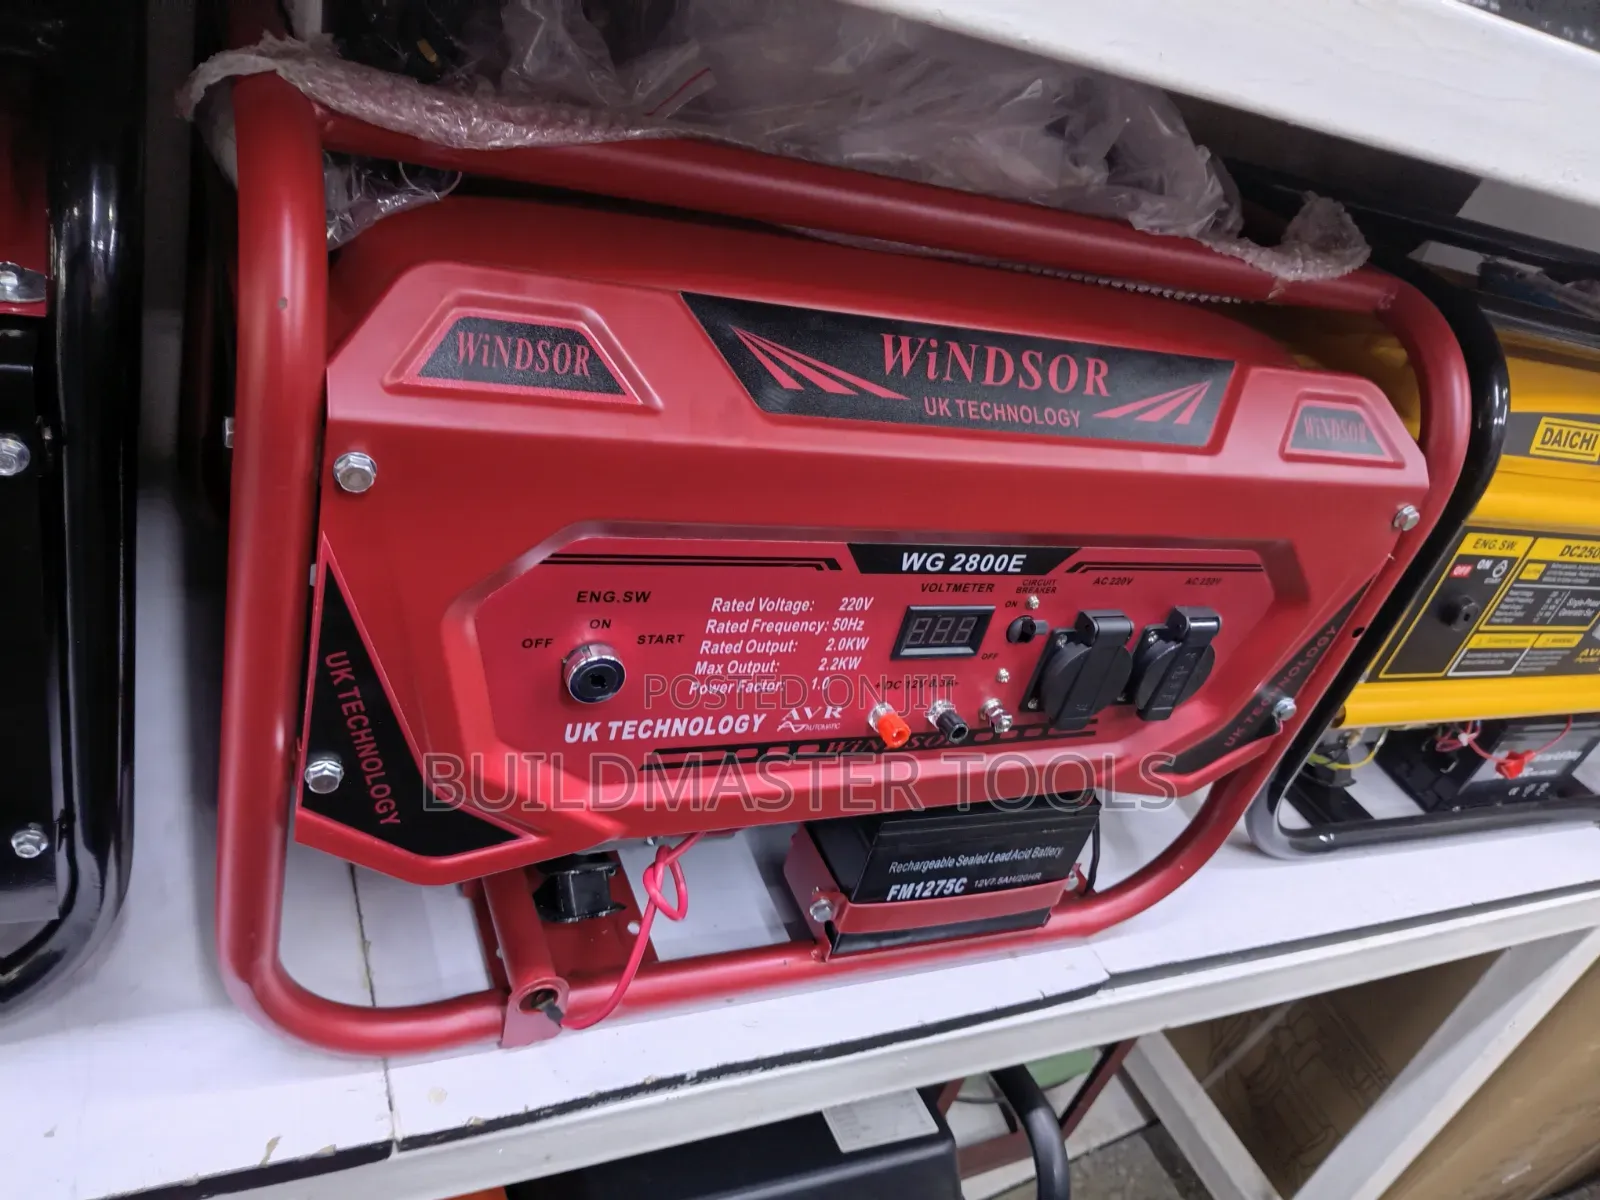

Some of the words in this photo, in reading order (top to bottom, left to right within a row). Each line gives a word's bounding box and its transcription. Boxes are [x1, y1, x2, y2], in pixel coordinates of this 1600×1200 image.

[457, 331, 592, 379] WiNDSOR
[880, 333, 1111, 397] WiNDSOR
[923, 396, 951, 417] UK
[955, 399, 1080, 429] TECHNOLOGY
[1540, 427, 1600, 452] DAICHI
[902, 552, 946, 572] WG
[949, 554, 1027, 573] 2800E
[1477, 559, 1494, 570] ON
[920, 583, 995, 593] VOLTMETER
[1015, 586, 1057, 595] BREAKER
[1022, 579, 1057, 587] CIRCUIT
[1092, 577, 1109, 586] AC
[1109, 577, 1135, 586] 220V
[1184, 578, 1200, 586] AC
[576, 590, 652, 604] ENG.SW
[711, 597, 756, 613] Rated
[757, 597, 815, 615] Voltage:
[838, 597, 875, 612] 220V
[1004, 601, 1018, 609] ON
[589, 619, 612, 630] ON
[705, 618, 749, 635] Rated
[750, 618, 830, 636] Frequency:
[831, 617, 866, 632] 50Hz
[521, 638, 554, 649] OFF
[636, 634, 685, 645] START
[699, 639, 743, 655] Rated
[745, 639, 798, 656] Output:
[824, 637, 870, 652] 2.0KW
[981, 652, 998, 661] OFF
[325, 650, 356, 686] UK
[694, 660, 723, 676] Max
[726, 659, 780, 677] Output:
[817, 656, 862, 671] 2.2KW
[689, 679, 734, 696] Power
[736, 679, 785, 695] Factor:
[811, 676, 830, 690] 1.0
[884, 680, 902, 690] DC
[781, 705, 843, 721] AVR
[564, 721, 602, 744] UK
[607, 713, 767, 741] TECHNOLOGY
[337, 686, 401, 825] TECHNOLOGY
[889, 859, 954, 875] Rechargeable
[955, 854, 988, 868] Sealed
[988, 849, 1012, 864] Lead
[1011, 847, 1032, 861] Acid
[1031, 846, 1065, 860] Battery
[886, 876, 968, 902] FM1275C
